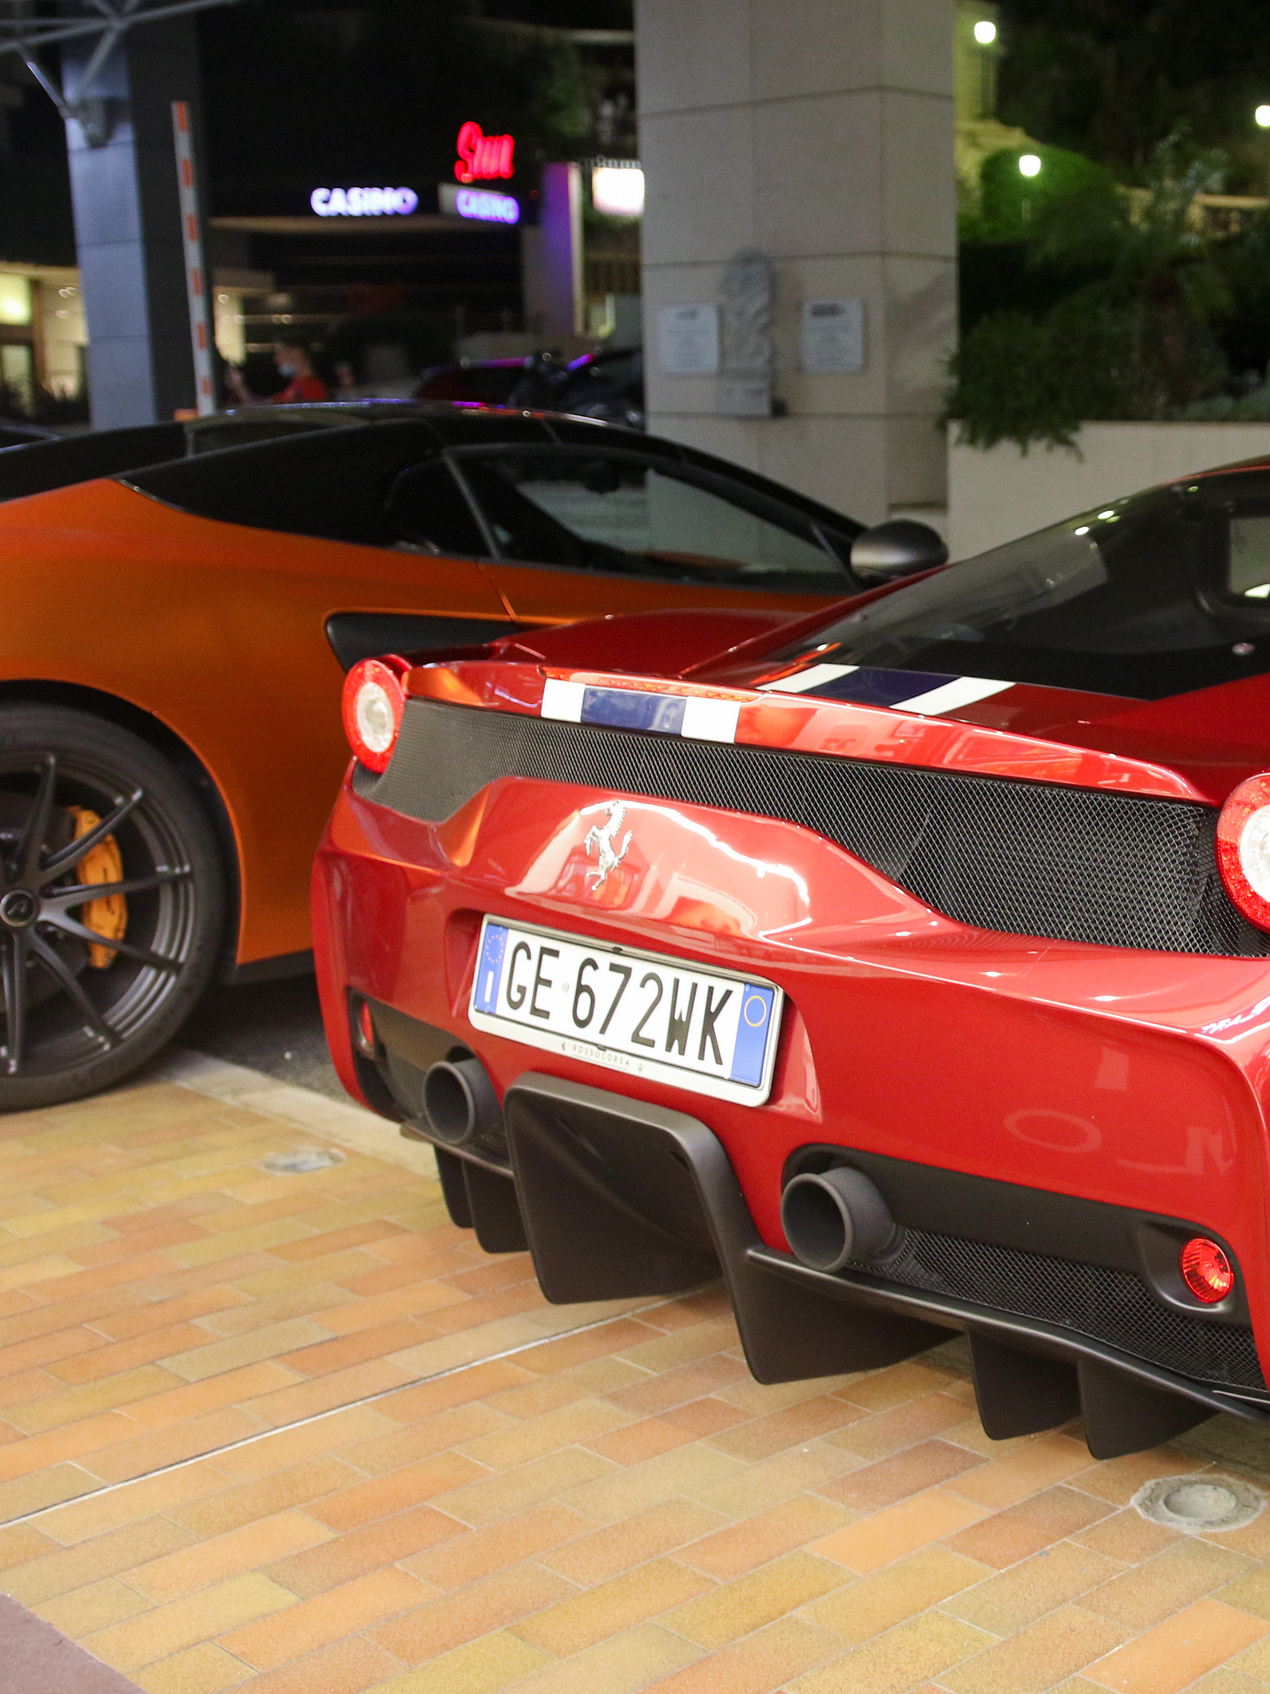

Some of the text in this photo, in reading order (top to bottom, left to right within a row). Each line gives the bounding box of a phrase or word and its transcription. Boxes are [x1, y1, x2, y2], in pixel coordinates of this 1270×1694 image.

[310, 187, 418, 217] CASINO
[456, 189, 519, 224] CASINO
[506, 941, 733, 1065] GE 672WK
[572, 1044, 630, 1066] ROSSOCORSA
